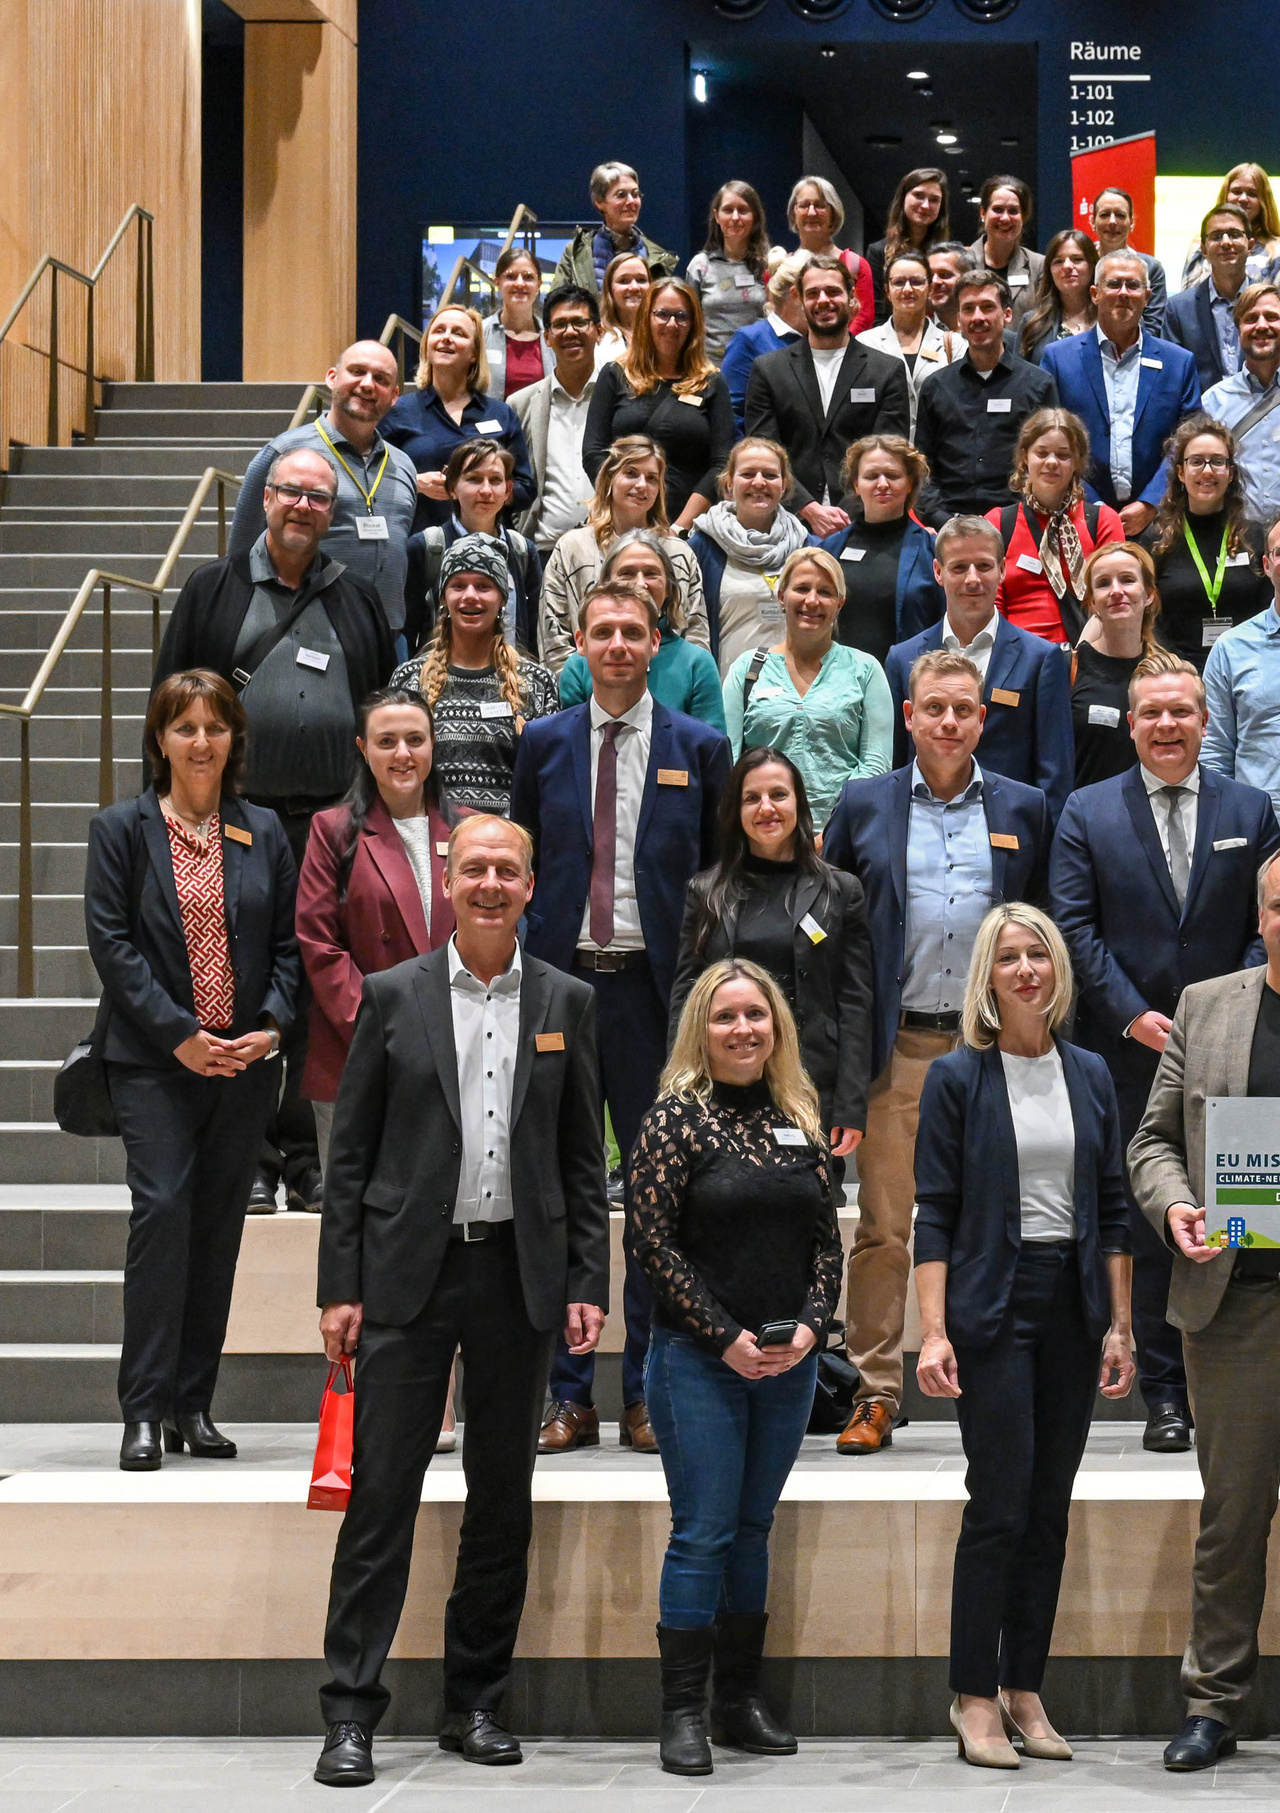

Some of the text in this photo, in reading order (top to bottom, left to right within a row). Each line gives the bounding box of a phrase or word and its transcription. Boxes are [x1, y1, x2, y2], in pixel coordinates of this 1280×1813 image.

[1070, 41, 1142, 60] Räume
[1070, 85, 1114, 100] 1-101
[1070, 110, 1115, 125] 1-102
[1215, 1153, 1240, 1168] EU
